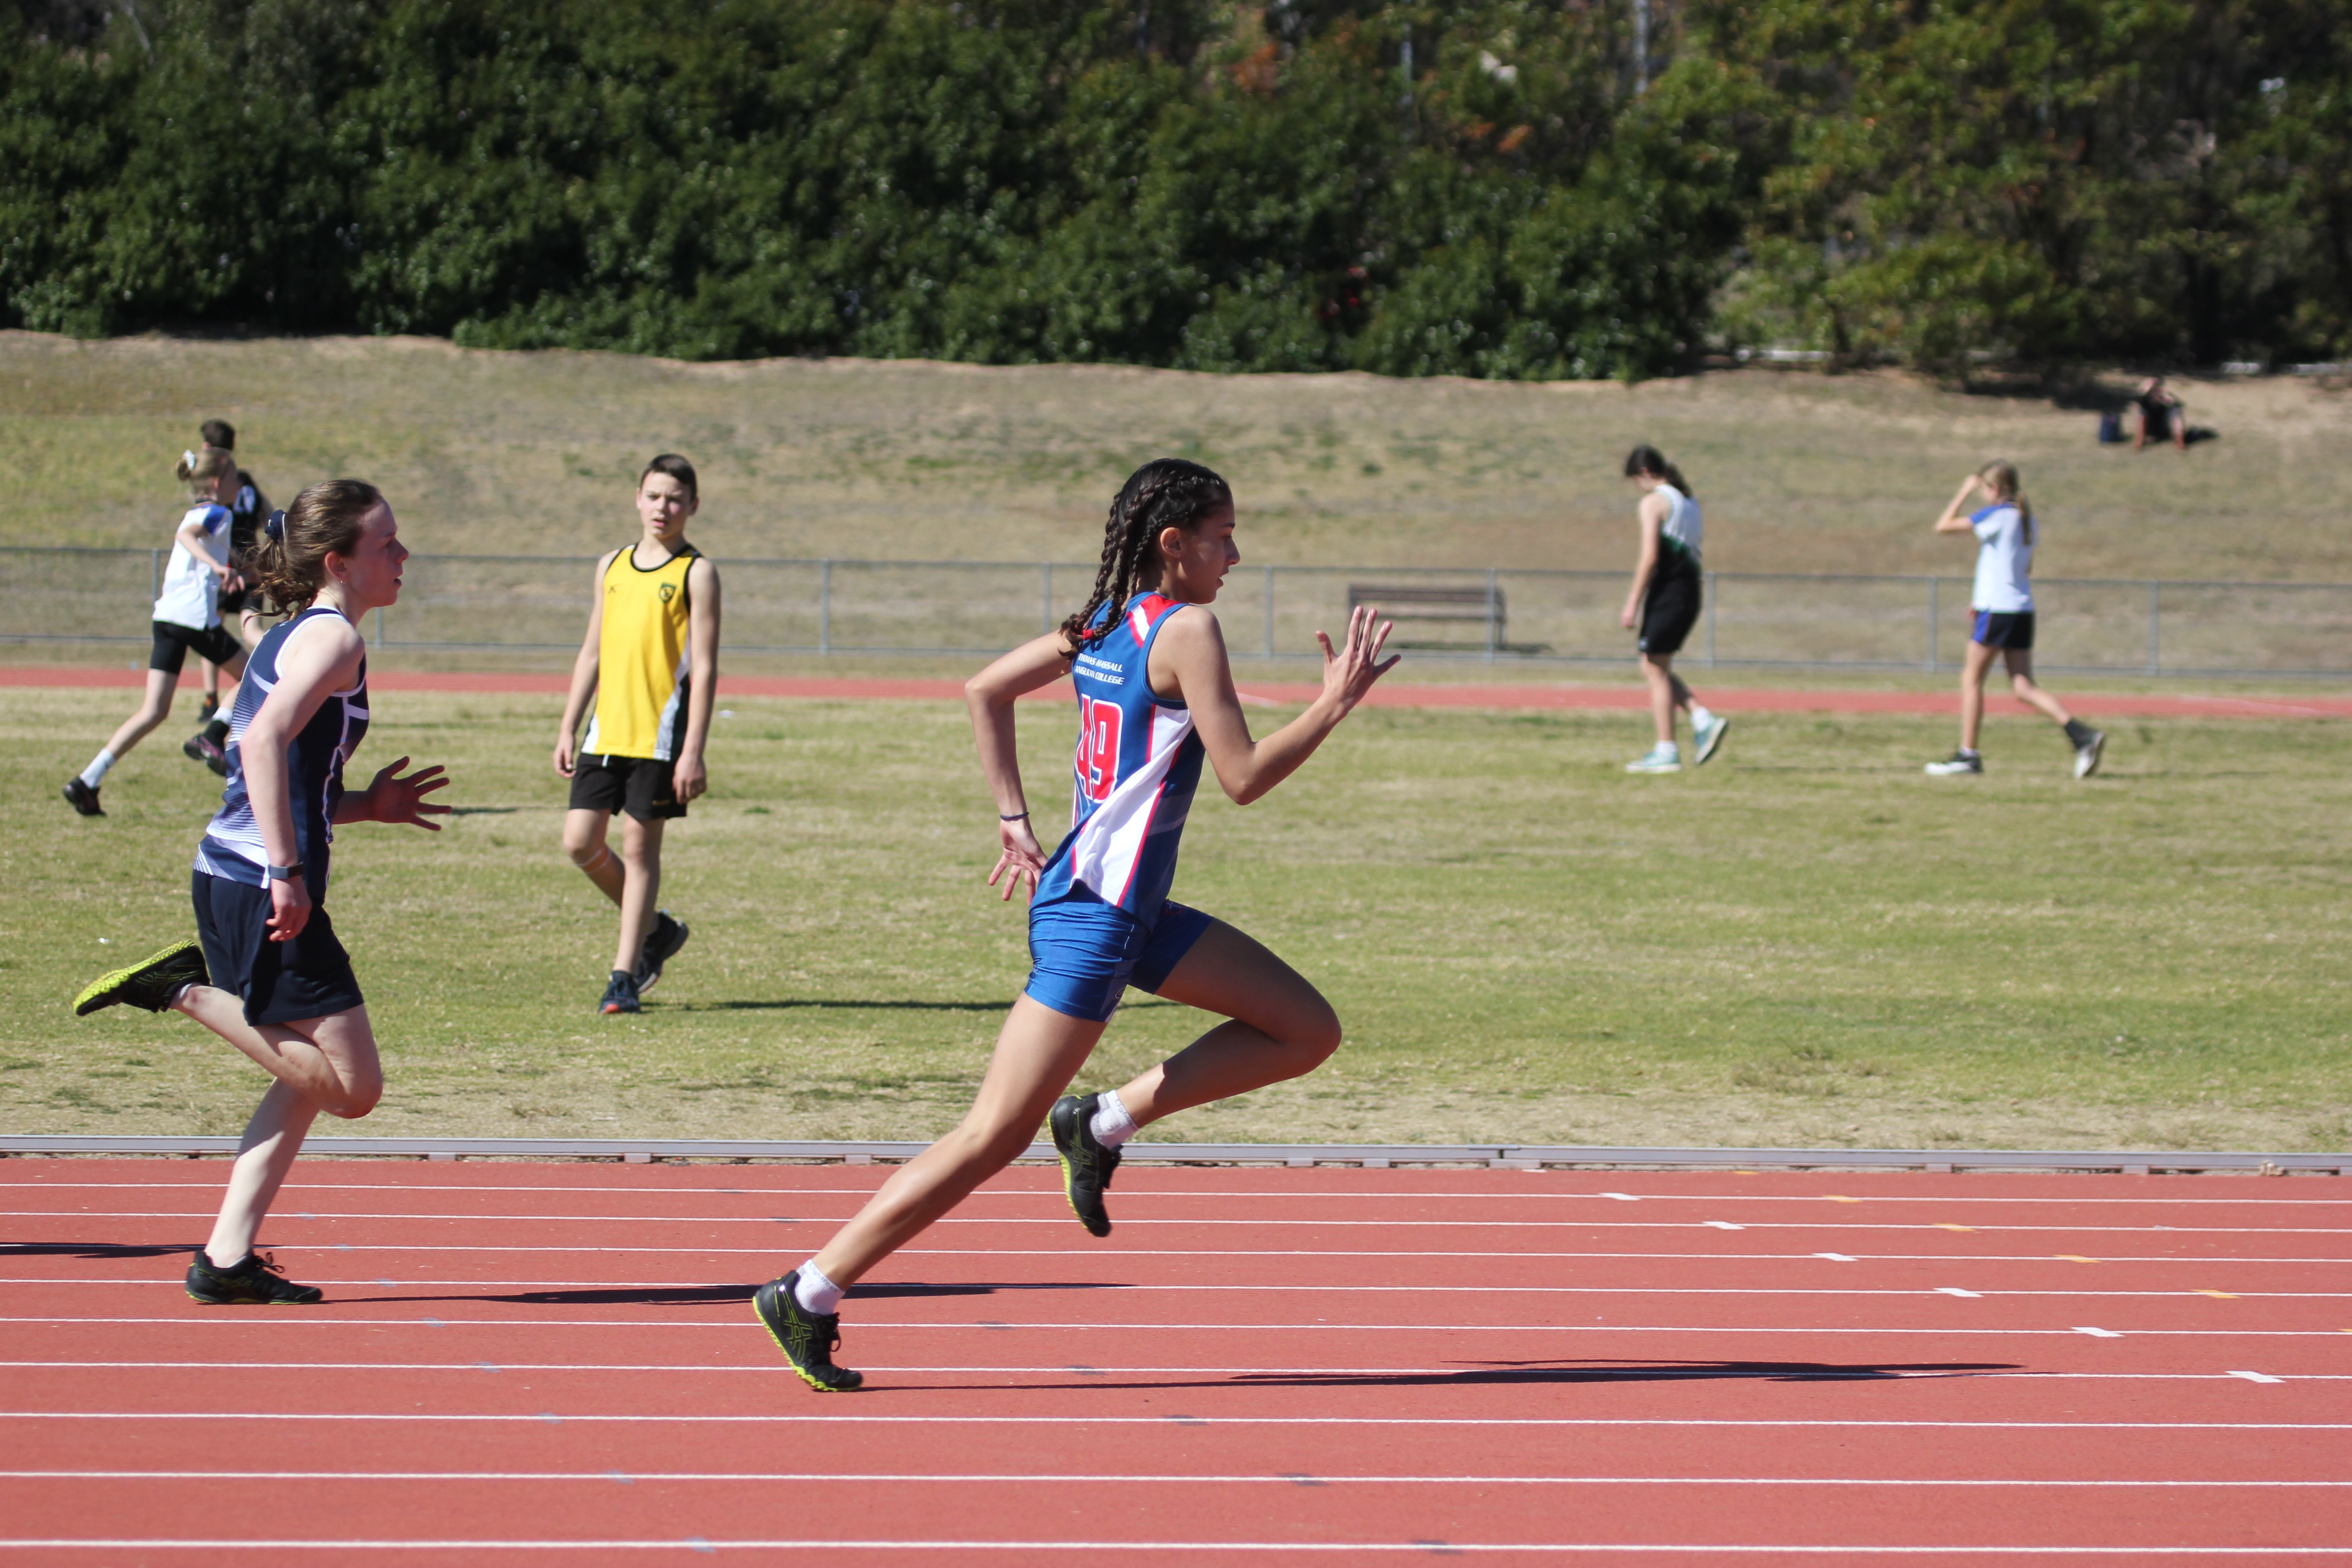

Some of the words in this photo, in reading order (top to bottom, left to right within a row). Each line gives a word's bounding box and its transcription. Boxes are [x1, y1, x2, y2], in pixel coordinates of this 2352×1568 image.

[1078, 653, 1097, 665] THOMAS
[1096, 659, 1122, 672] HASSALL
[1075, 665, 1095, 678] ANGLICAN
[1095, 671, 1125, 685] COLLEGE
[1076, 693, 1123, 804] 49
